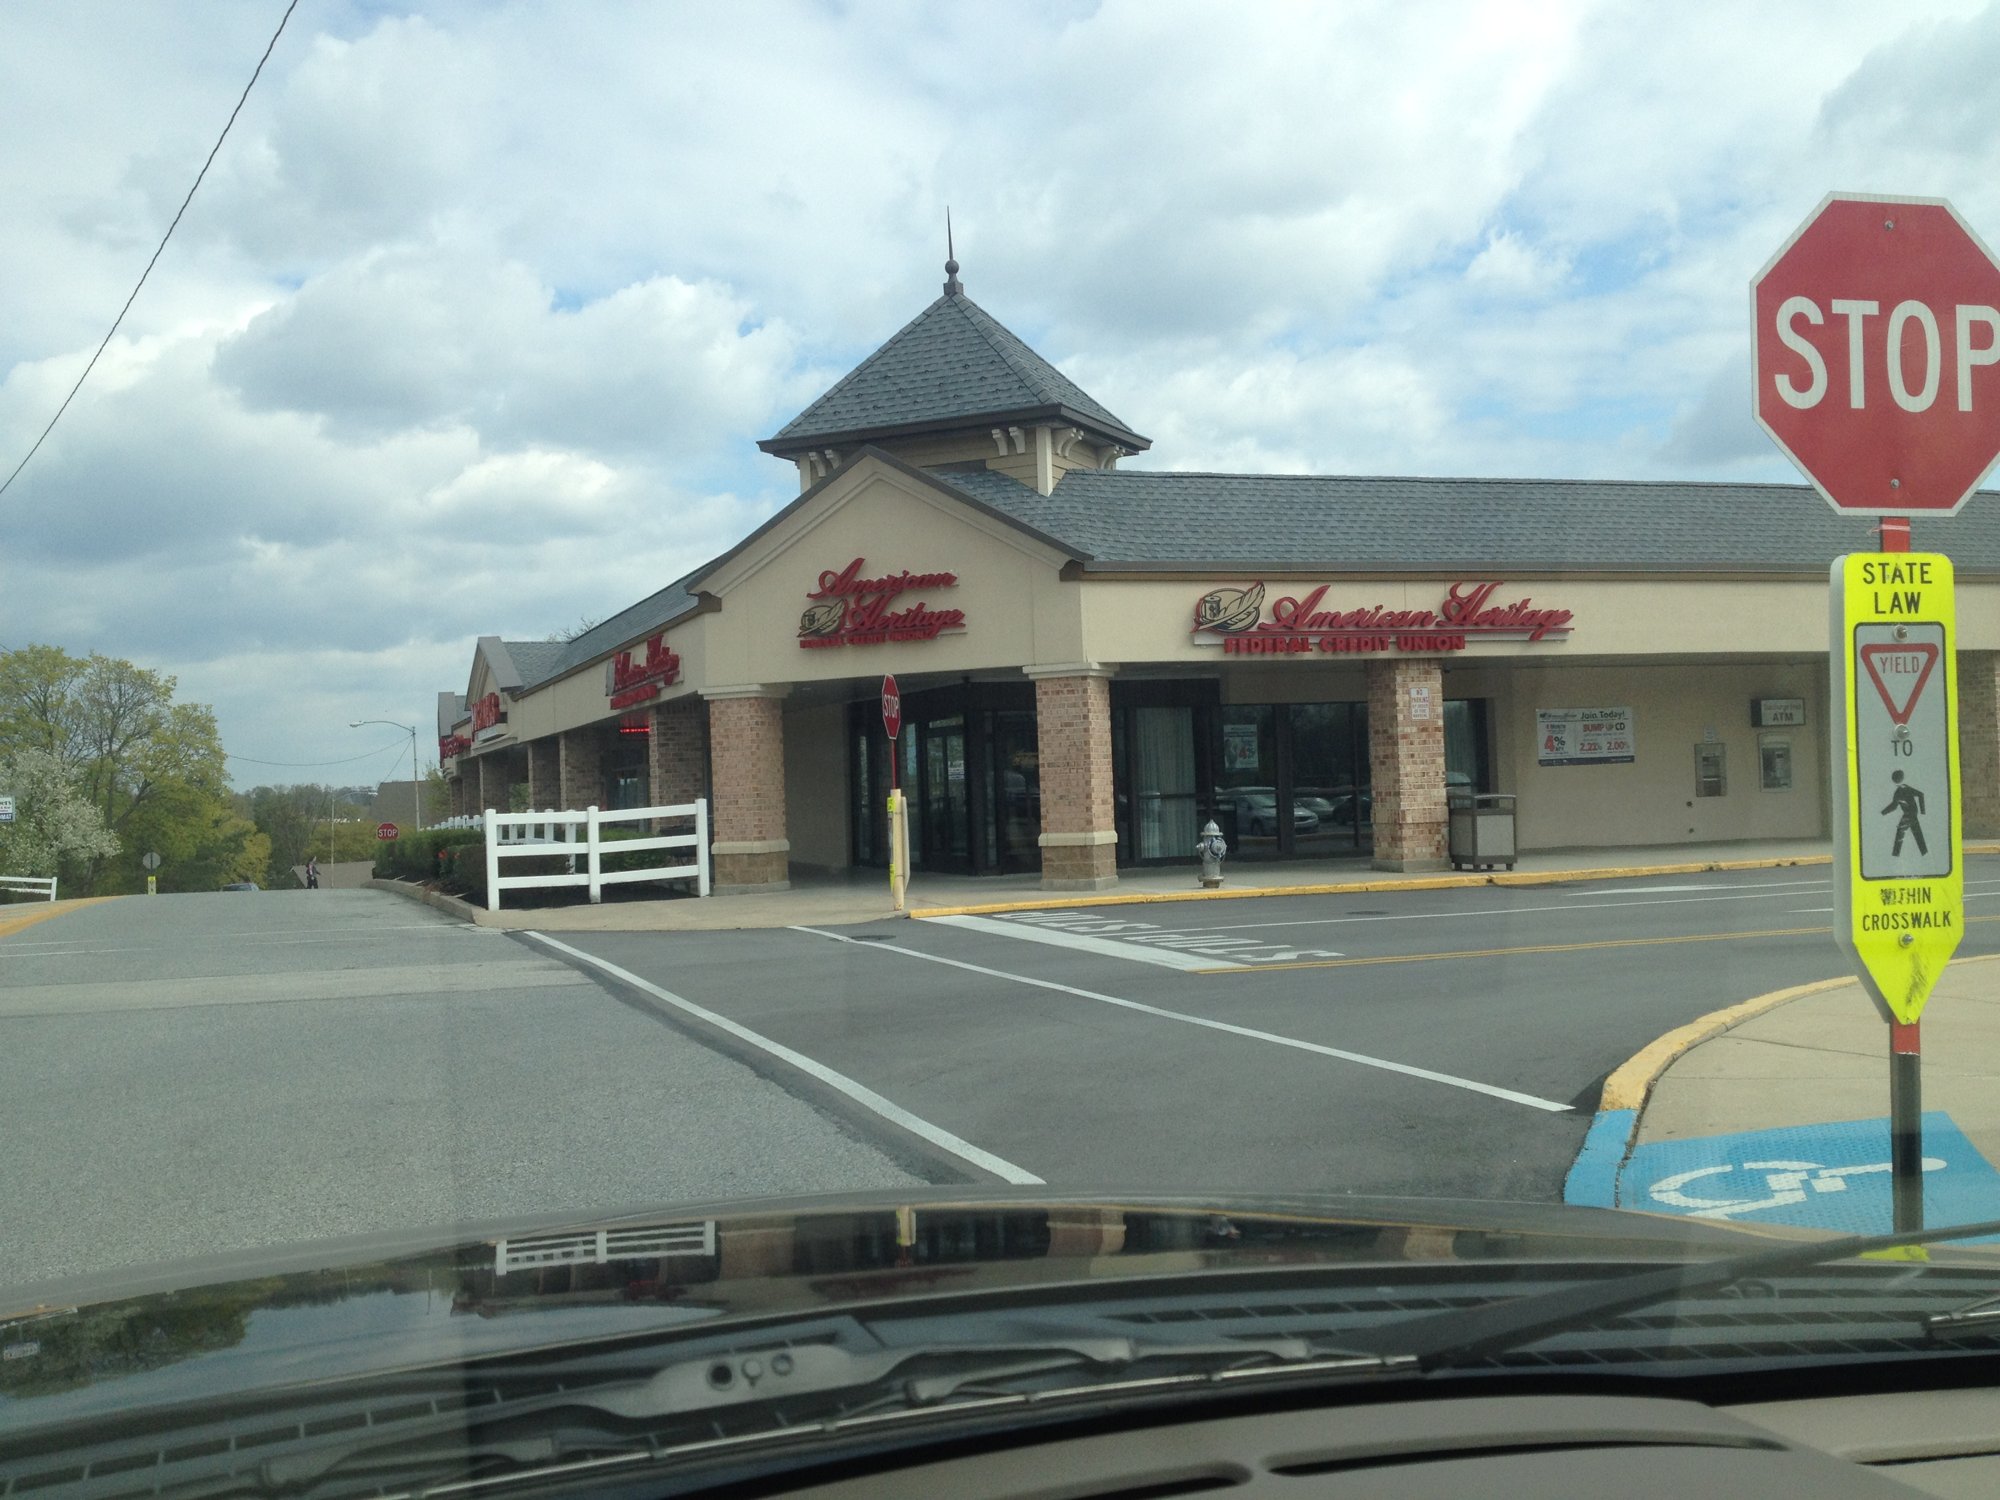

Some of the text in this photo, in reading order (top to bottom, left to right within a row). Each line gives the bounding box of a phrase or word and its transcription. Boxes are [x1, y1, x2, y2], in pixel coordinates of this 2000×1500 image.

[1774, 296, 2000, 413] STOP
[807, 558, 958, 599] American
[1863, 562, 1933, 584] STATE
[1257, 581, 1574, 641] American Heritage
[1874, 591, 1921, 614] LAW
[846, 590, 966, 640] Heritage
[1223, 635, 1465, 654] FEDERAL CREDIT UNION
[1880, 656, 1920, 674] YIELD
[884, 694, 899, 718] STOP
[1581, 712, 1598, 720] Join
[1600, 711, 1625, 720] Today!
[1772, 712, 1794, 721] ATM
[1615, 722, 1625, 731] CD
[1891, 740, 1913, 757] TO
[379, 829, 397, 837] STOP
[1881, 887, 1931, 905] WITHIN
[1863, 911, 1951, 931] CROSSWALK
